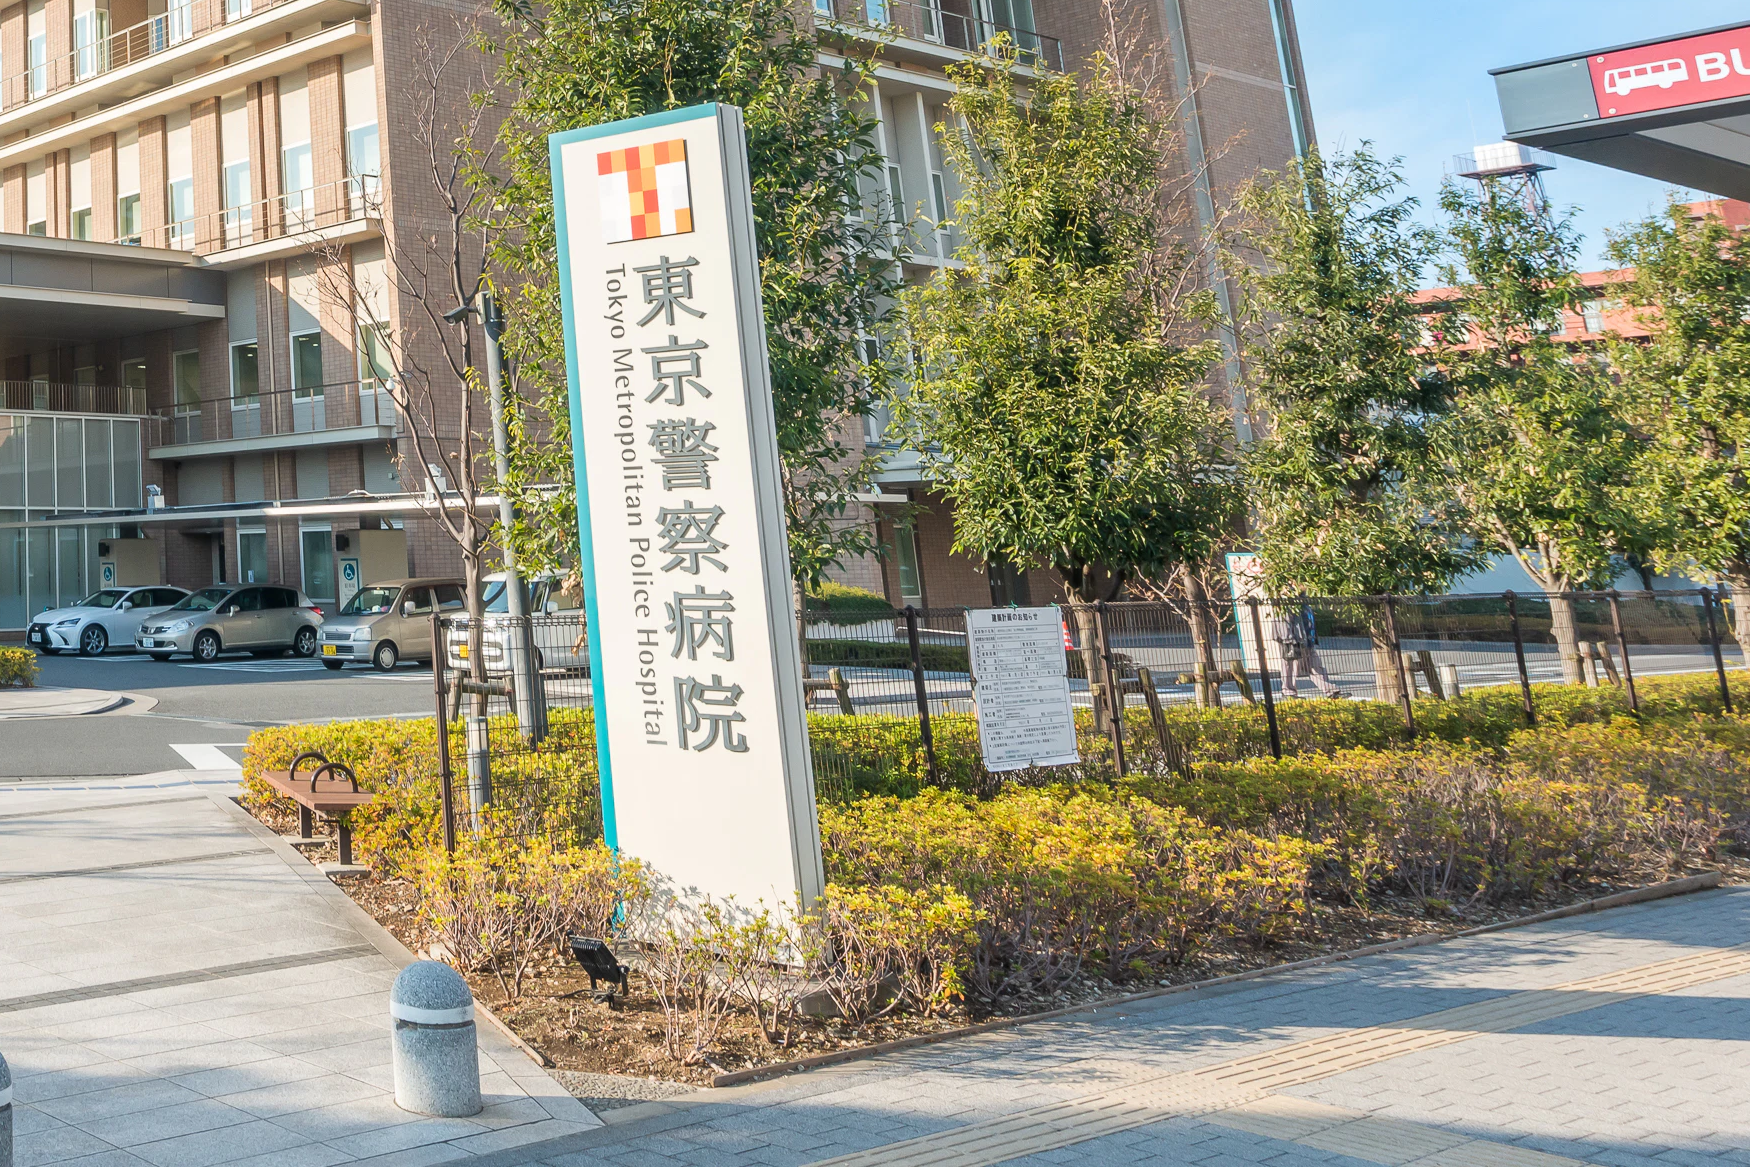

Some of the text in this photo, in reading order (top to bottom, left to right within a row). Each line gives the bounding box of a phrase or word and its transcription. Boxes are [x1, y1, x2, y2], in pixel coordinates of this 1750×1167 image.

[604, 263, 668, 745] Tokyo Metropolitan Police Hospital
[632, 255, 750, 752] 東京警察病院
